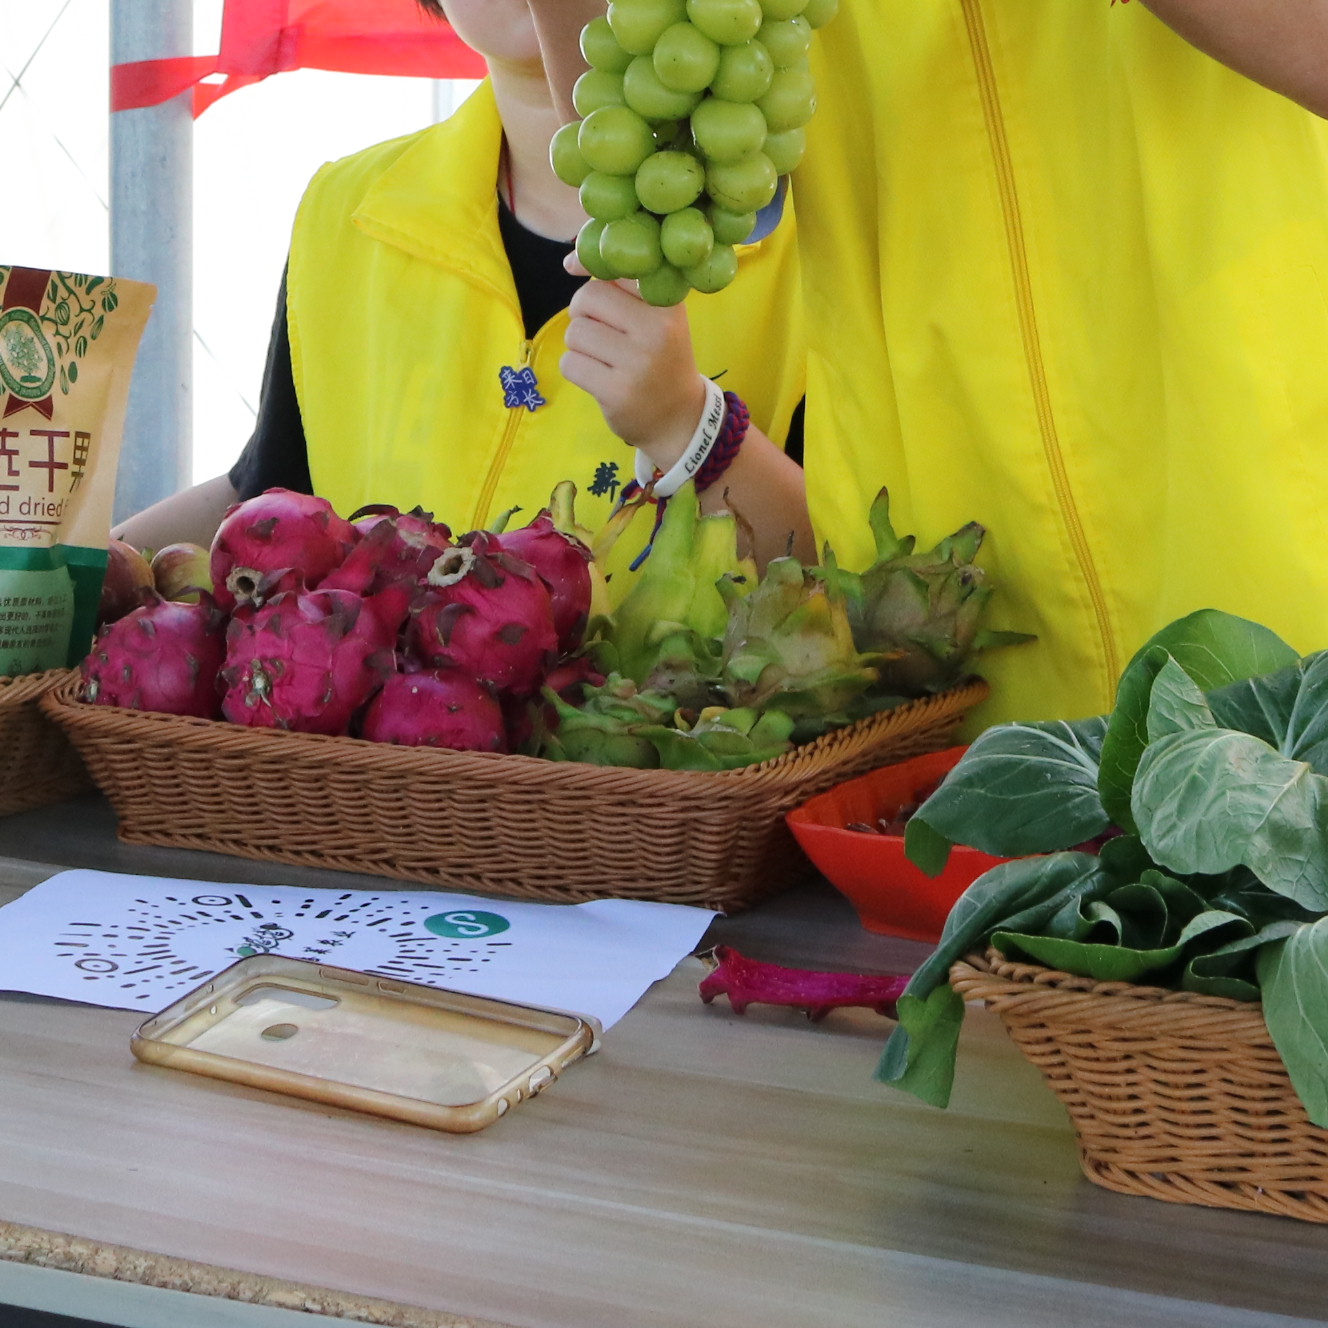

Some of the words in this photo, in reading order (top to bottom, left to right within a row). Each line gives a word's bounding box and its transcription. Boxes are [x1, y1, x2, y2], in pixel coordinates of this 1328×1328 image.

[501, 369, 535, 390] 来日
[506, 389, 543, 411] 方长
[684, 428, 713, 474] Lionel
[707, 394, 723, 430] Messi
[19, 496, 63, 517] dried
